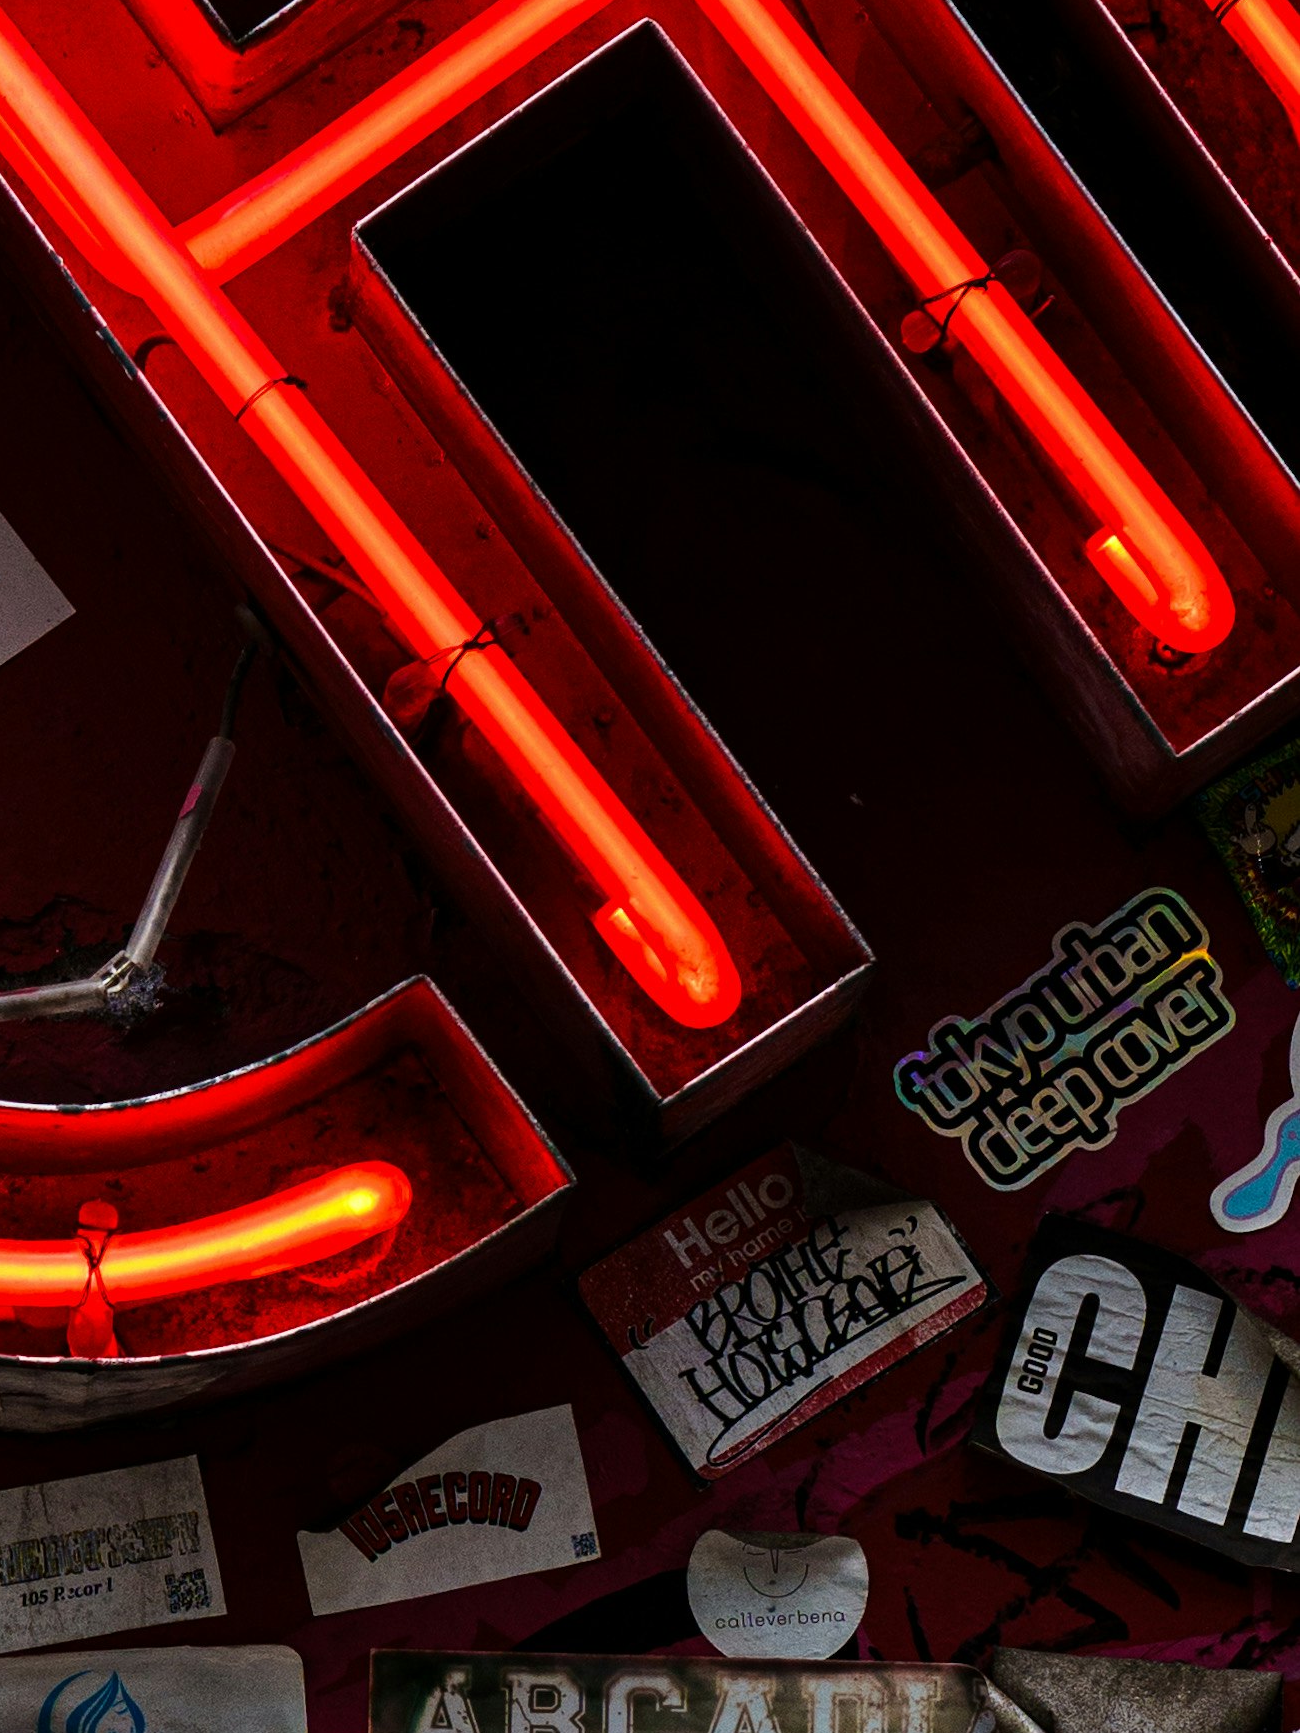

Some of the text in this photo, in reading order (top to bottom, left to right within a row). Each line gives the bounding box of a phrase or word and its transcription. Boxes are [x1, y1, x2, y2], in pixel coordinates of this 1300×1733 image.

[906, 901, 1196, 1120] tokyo urban
[975, 972, 1227, 1179] deep cover
[663, 1174, 794, 1268] Hello
[1019, 1325, 1059, 1396] GOOD
[715, 1608, 847, 1631] calleverbena
